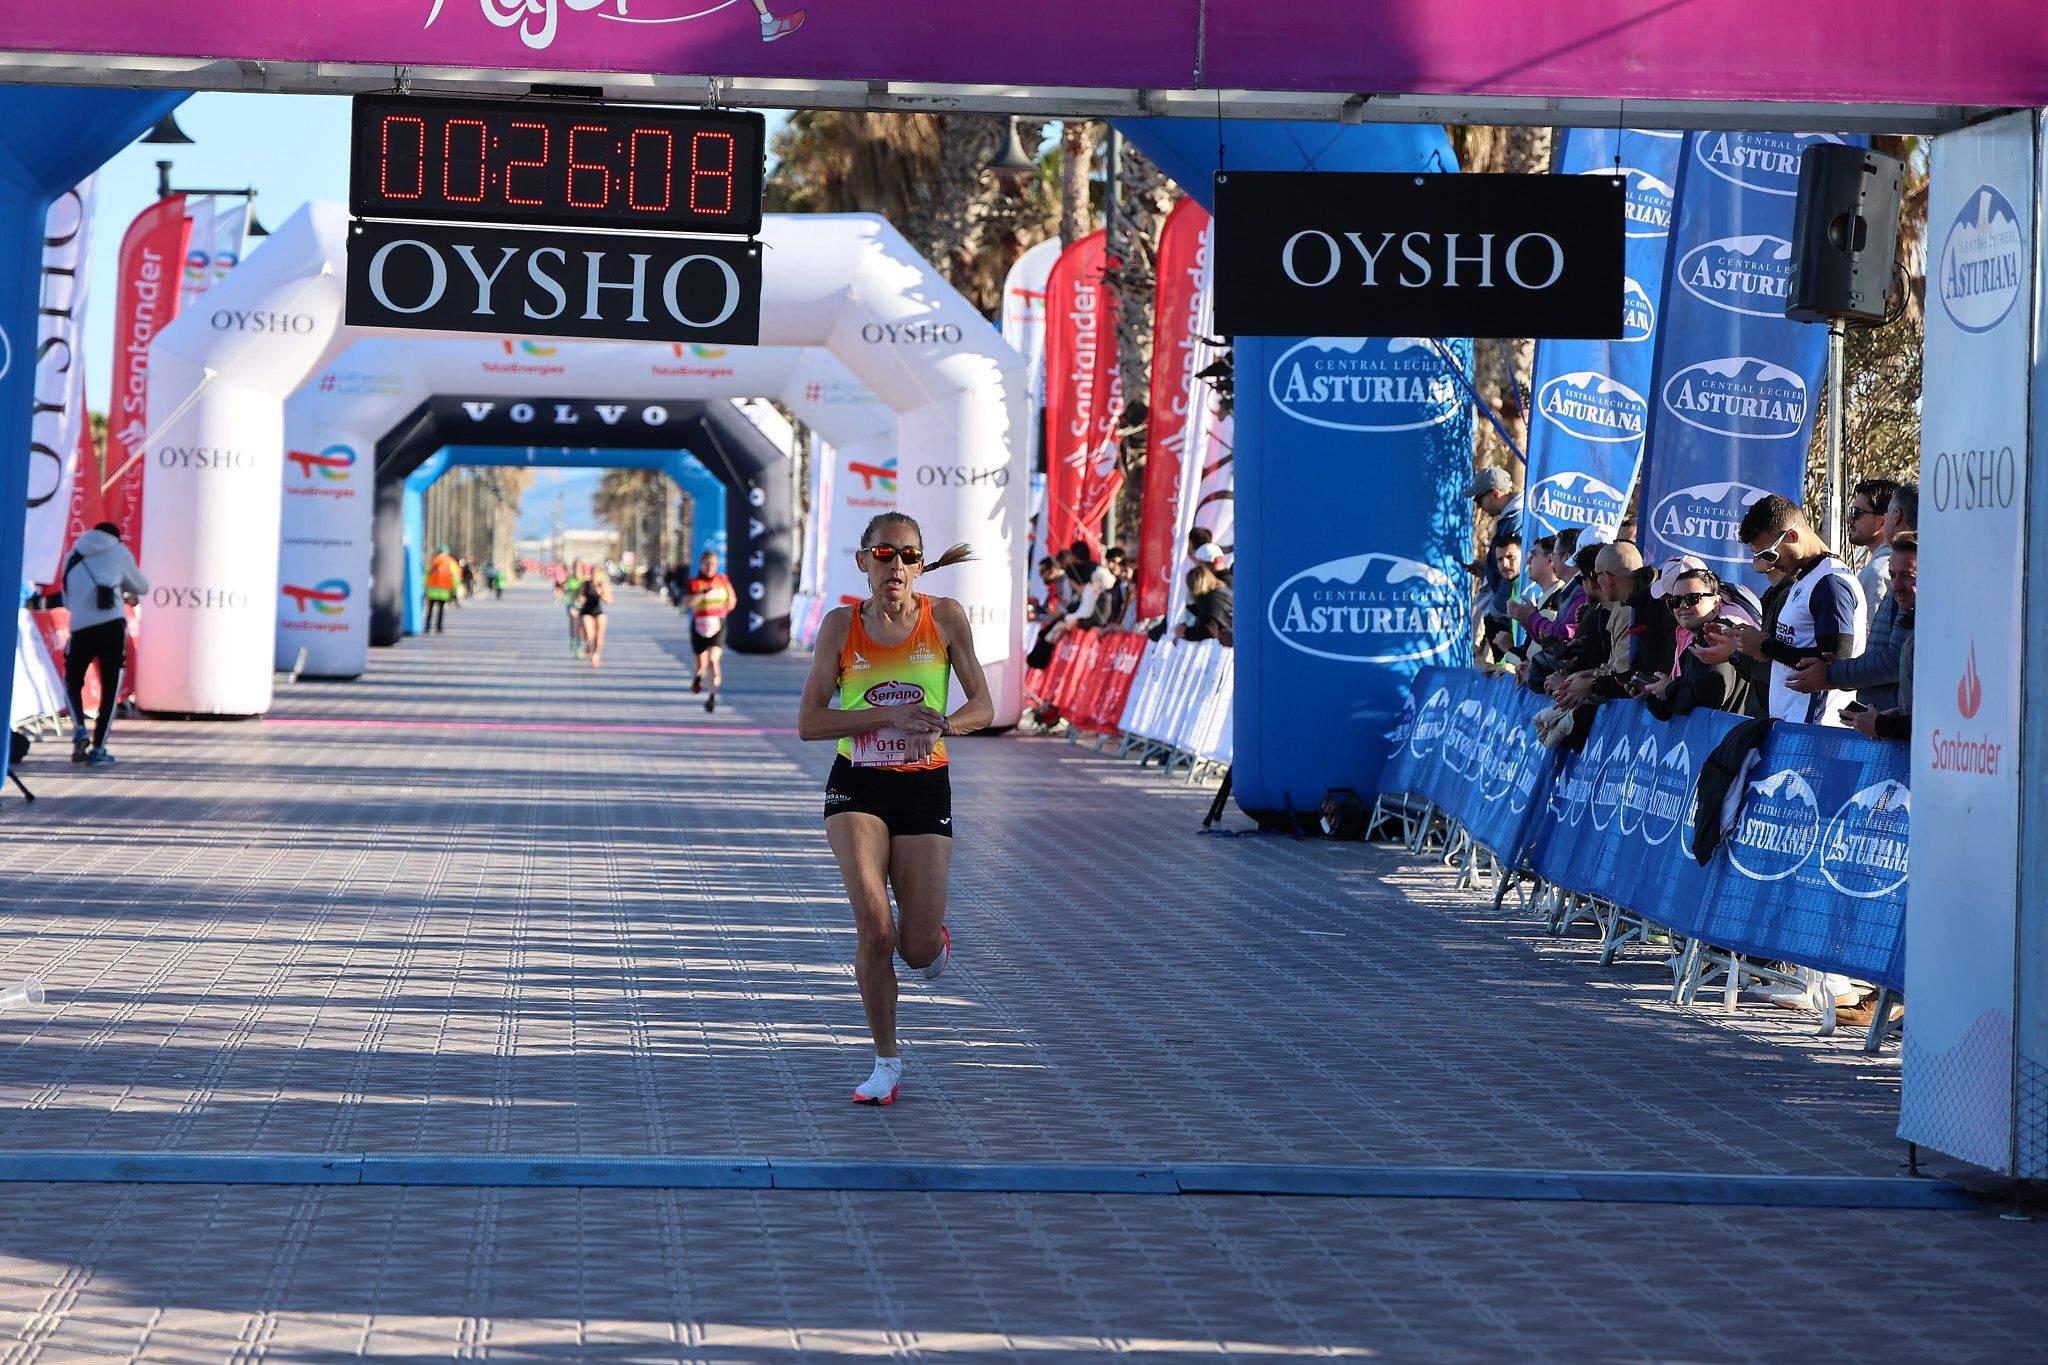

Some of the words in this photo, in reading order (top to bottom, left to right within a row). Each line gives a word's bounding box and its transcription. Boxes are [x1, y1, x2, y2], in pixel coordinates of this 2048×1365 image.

[1737, 134, 1791, 150] CENTRAL
[382, 115, 735, 215] 00:26:08
[1282, 230, 1565, 289] OYSHO
[1718, 256, 1771, 272] CENTRAL
[368, 239, 741, 328] OYSHO
[1945, 246, 2018, 300] ASTURIANA
[124, 249, 163, 412] Santander
[211, 309, 314, 334] OYSHO
[861, 322, 963, 345] OYSHO
[1069, 280, 1097, 437] Santander
[1315, 359, 1388, 371] CENTRAL
[1701, 379, 1754, 394] CENTRAL
[1545, 387, 1642, 432] ASTURIANA
[1565, 388, 1597, 402] CENTRAL
[1599, 398, 1642, 412] LECHERA
[461, 402, 669, 426] VOLVO
[159, 446, 255, 470] OYSHO
[916, 464, 1010, 488] OYSHO
[1933, 446, 2015, 513] OYSHO
[1687, 505, 1739, 518] CENTRAL
[748, 487, 766, 632] VOLVO
[153, 586, 249, 610] OYSHO
[1313, 590, 1386, 602] CENTRAL
[870, 689, 921, 702] Serrano
[1931, 729, 2002, 776] Santander
[1732, 802, 1808, 857] ASTURIANA
